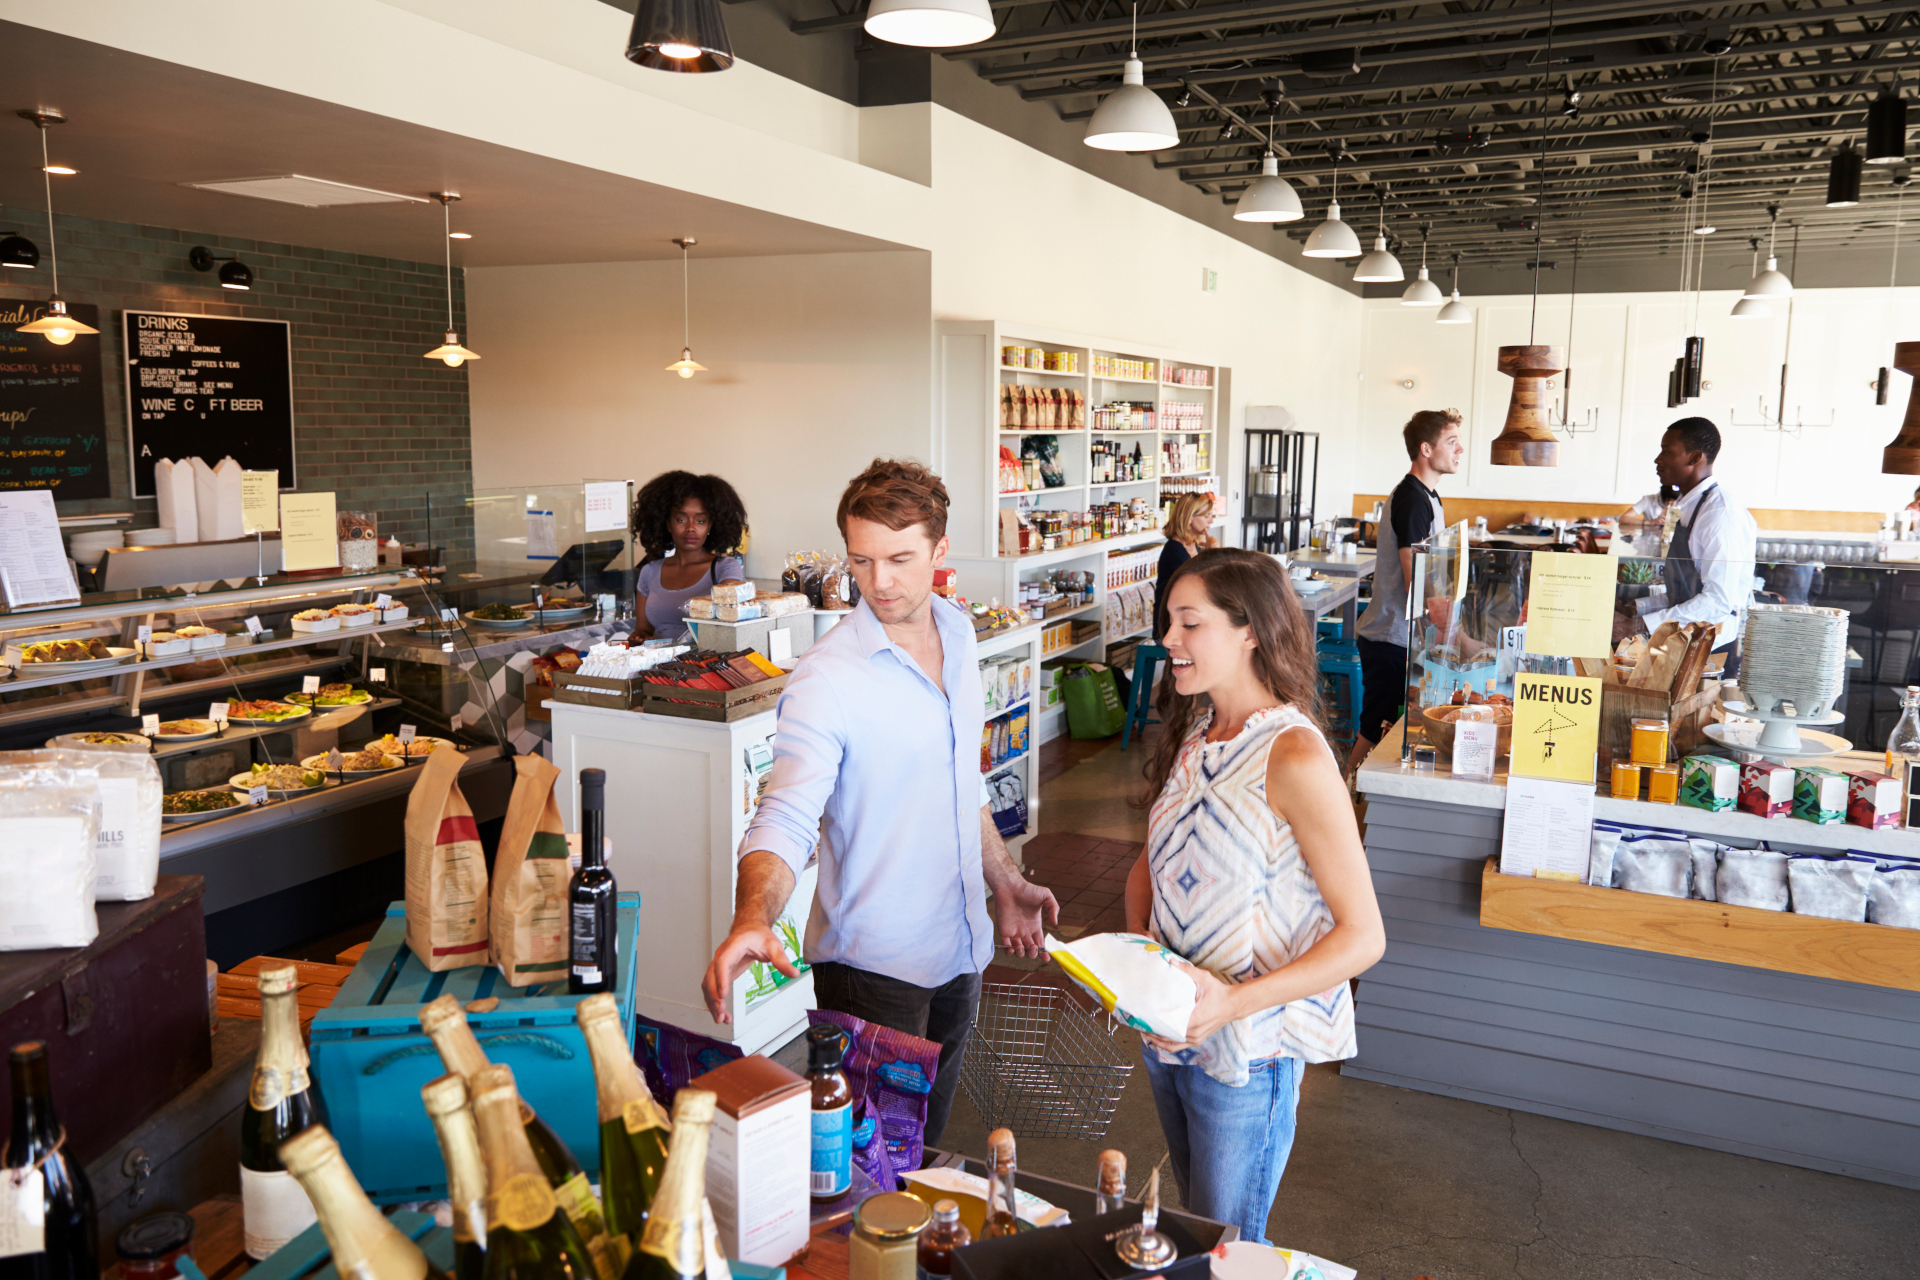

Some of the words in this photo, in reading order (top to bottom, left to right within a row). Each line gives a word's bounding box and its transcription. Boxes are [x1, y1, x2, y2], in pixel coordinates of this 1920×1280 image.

[138, 315, 189, 331] DRINKS
[138, 330, 166, 339] ORGANIC
[167, 331, 183, 339] ICED
[183, 332, 195, 340] TEA
[139, 337, 160, 345] HOUSE
[162, 338, 195, 346] LEMONADE
[191, 360, 217, 368] COFFEES
[225, 361, 240, 369] TEAS
[158, 368, 175, 376] BREW
[175, 381, 197, 389] DRINKS
[173, 387, 198, 395] ORGANIC
[141, 399, 176, 411] WINE
[184, 399, 195, 412] C
[230, 399, 263, 411] BEER
[23, 435, 71, 446] GAZPACHO
[141, 444, 152, 457] A
[30, 466, 56, 477] BEAN
[1508, 629, 1515, 648] 9
[1520, 683, 1593, 706] MENUS
[889, 1065, 920, 1078] POPCORN
